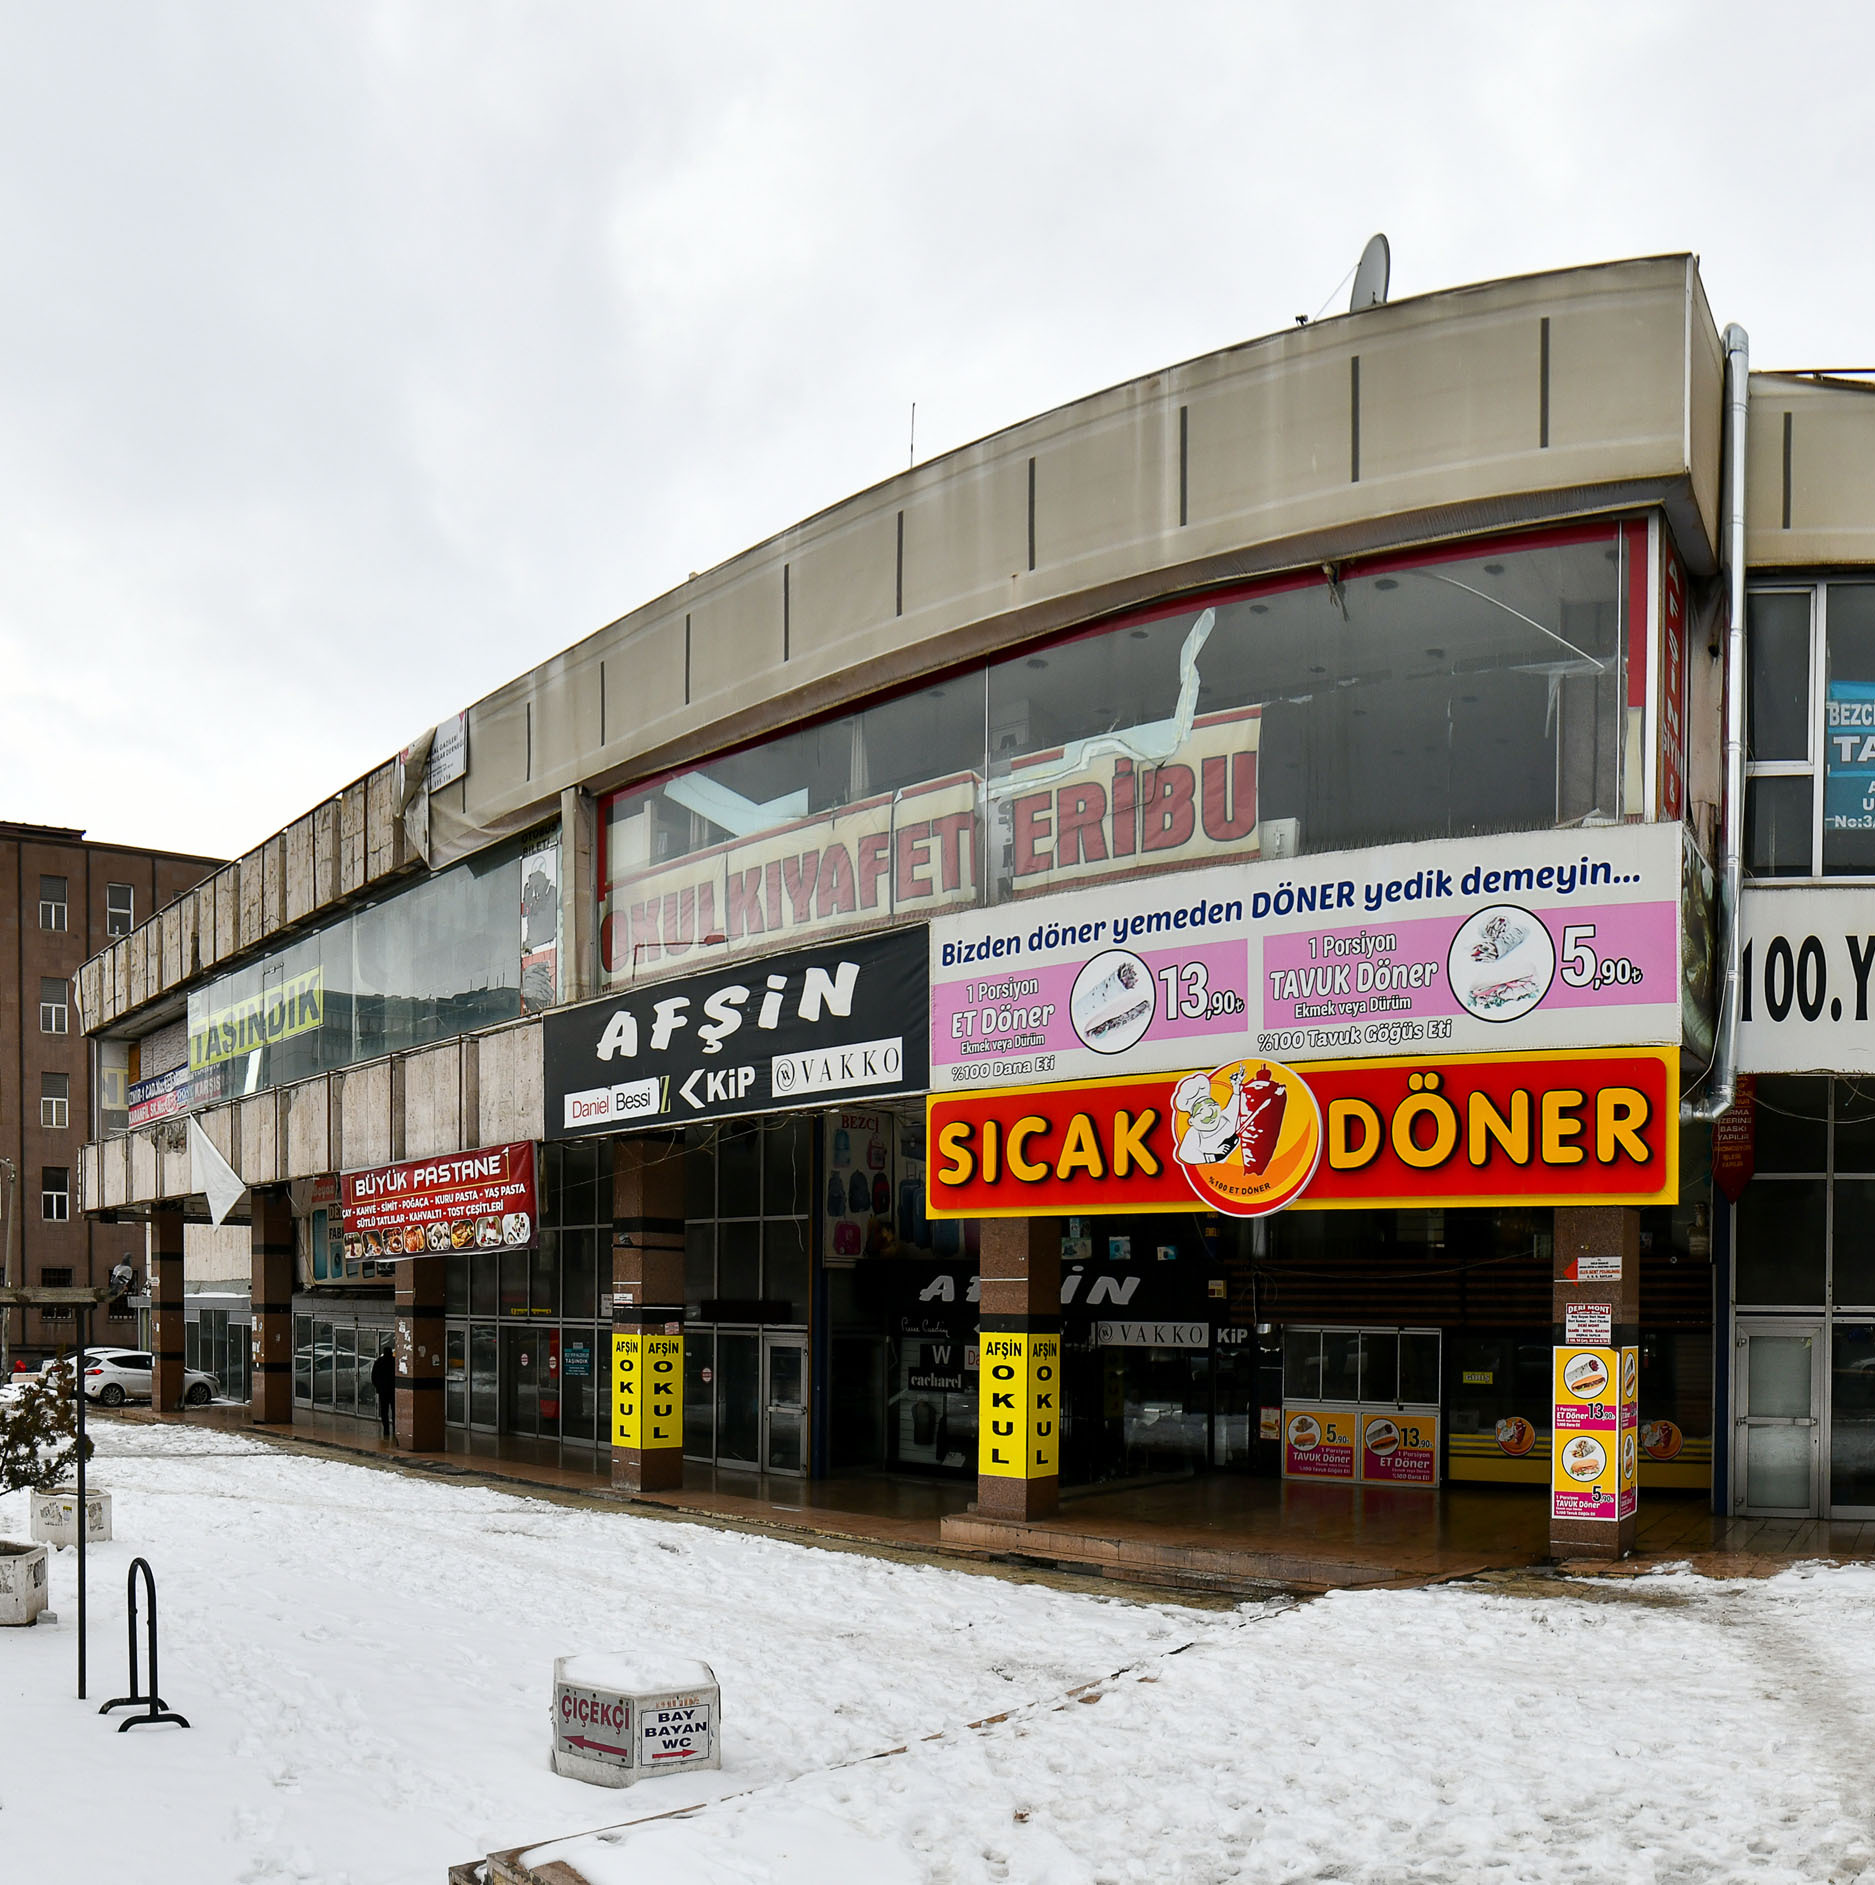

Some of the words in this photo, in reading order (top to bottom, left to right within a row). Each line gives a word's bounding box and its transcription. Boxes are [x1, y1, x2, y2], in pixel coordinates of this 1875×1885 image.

[602, 880, 729, 974] OKUL
[728, 811, 976, 936] KIYAFET
[941, 937, 1027, 967] Bizden
[1028, 919, 1107, 951] döner
[1112, 901, 1243, 944] yemeden
[1252, 880, 1355, 921] DÖNER
[1364, 869, 1452, 906] yedik
[1460, 855, 1641, 896] demeyin...
[1322, 932, 1396, 958] Porsiyon
[978, 976, 1039, 1002] Porsiyon
[1270, 966, 1351, 1000] TAVUK
[1355, 959, 1438, 991] Döner
[191, 975, 320, 1063] TAŞINDIK
[596, 961, 861, 1061] AFŞİN
[951, 1011, 978, 1038] ET
[980, 1002, 1055, 1034] Döner
[1294, 1002, 1336, 1019] Ekmek
[1338, 1001, 1367, 1016] veya
[1368, 996, 1412, 1013] Dürüm
[960, 1039, 991, 1055] Ekmek
[992, 1036, 1013, 1052] veya
[1013, 1033, 1045, 1049] Dürüm
[1257, 1030, 1302, 1052] %100
[1307, 1026, 1361, 1048] Tavuk
[1364, 1022, 1423, 1047] Göğüs
[1427, 1018, 1453, 1040] Eti
[951, 1062, 990, 1080] %100
[993, 1059, 1033, 1078] Dana
[1034, 1055, 1055, 1074] Eti
[572, 1090, 610, 1119] Daniel
[616, 1087, 651, 1112] Bessi
[802, 1046, 900, 1084] VAKKO
[936, 1107, 1161, 1190] SICAK
[1326, 1070, 1652, 1173] DÖNER
[355, 1168, 408, 1197] BÜYÜK
[413, 1155, 501, 1189] PASTANE
[1241, 1183, 1271, 1195] DÖNER
[356, 1204, 377, 1216] KAHVE
[381, 1201, 398, 1213] SİMİT
[402, 1197, 429, 1209] POĞAÇA
[435, 1194, 454, 1205] KURU
[454, 1192, 479, 1203] PASTA
[483, 1188, 500, 1199] YAŞ
[500, 1183, 526, 1195] PASTA
[377, 1213, 405, 1225] TATLILAR
[409, 1209, 442, 1222] KAHVALTI
[448, 1206, 465, 1218] TOST
[465, 1199, 504, 1217] ÇEŞİTLERİ
[616, 1339, 638, 1355] AFŞİN
[1120, 1324, 1203, 1344] VAKKO
[648, 1340, 679, 1357] AFŞİN
[985, 1338, 1023, 1360] AFŞİN
[1032, 1339, 1058, 1361] AFŞİN
[911, 1372, 962, 1389] cacharel
[619, 1359, 634, 1438] OKUL
[653, 1360, 673, 1439] OKUL
[991, 1364, 1016, 1465] OKUL
[1036, 1365, 1053, 1465] OKUL
[1293, 1452, 1321, 1462] TAVUK
[1323, 1453, 1350, 1463] Döner
[1380, 1457, 1393, 1467] ET
[1395, 1458, 1430, 1469] Döner
[1556, 1500, 1578, 1508] TAVUK
[561, 1691, 630, 1735] ÇİÇEKÇİ
[658, 1709, 696, 1723] BAY
[645, 1721, 707, 1738] BAYAN
[662, 1737, 692, 1749] WC
